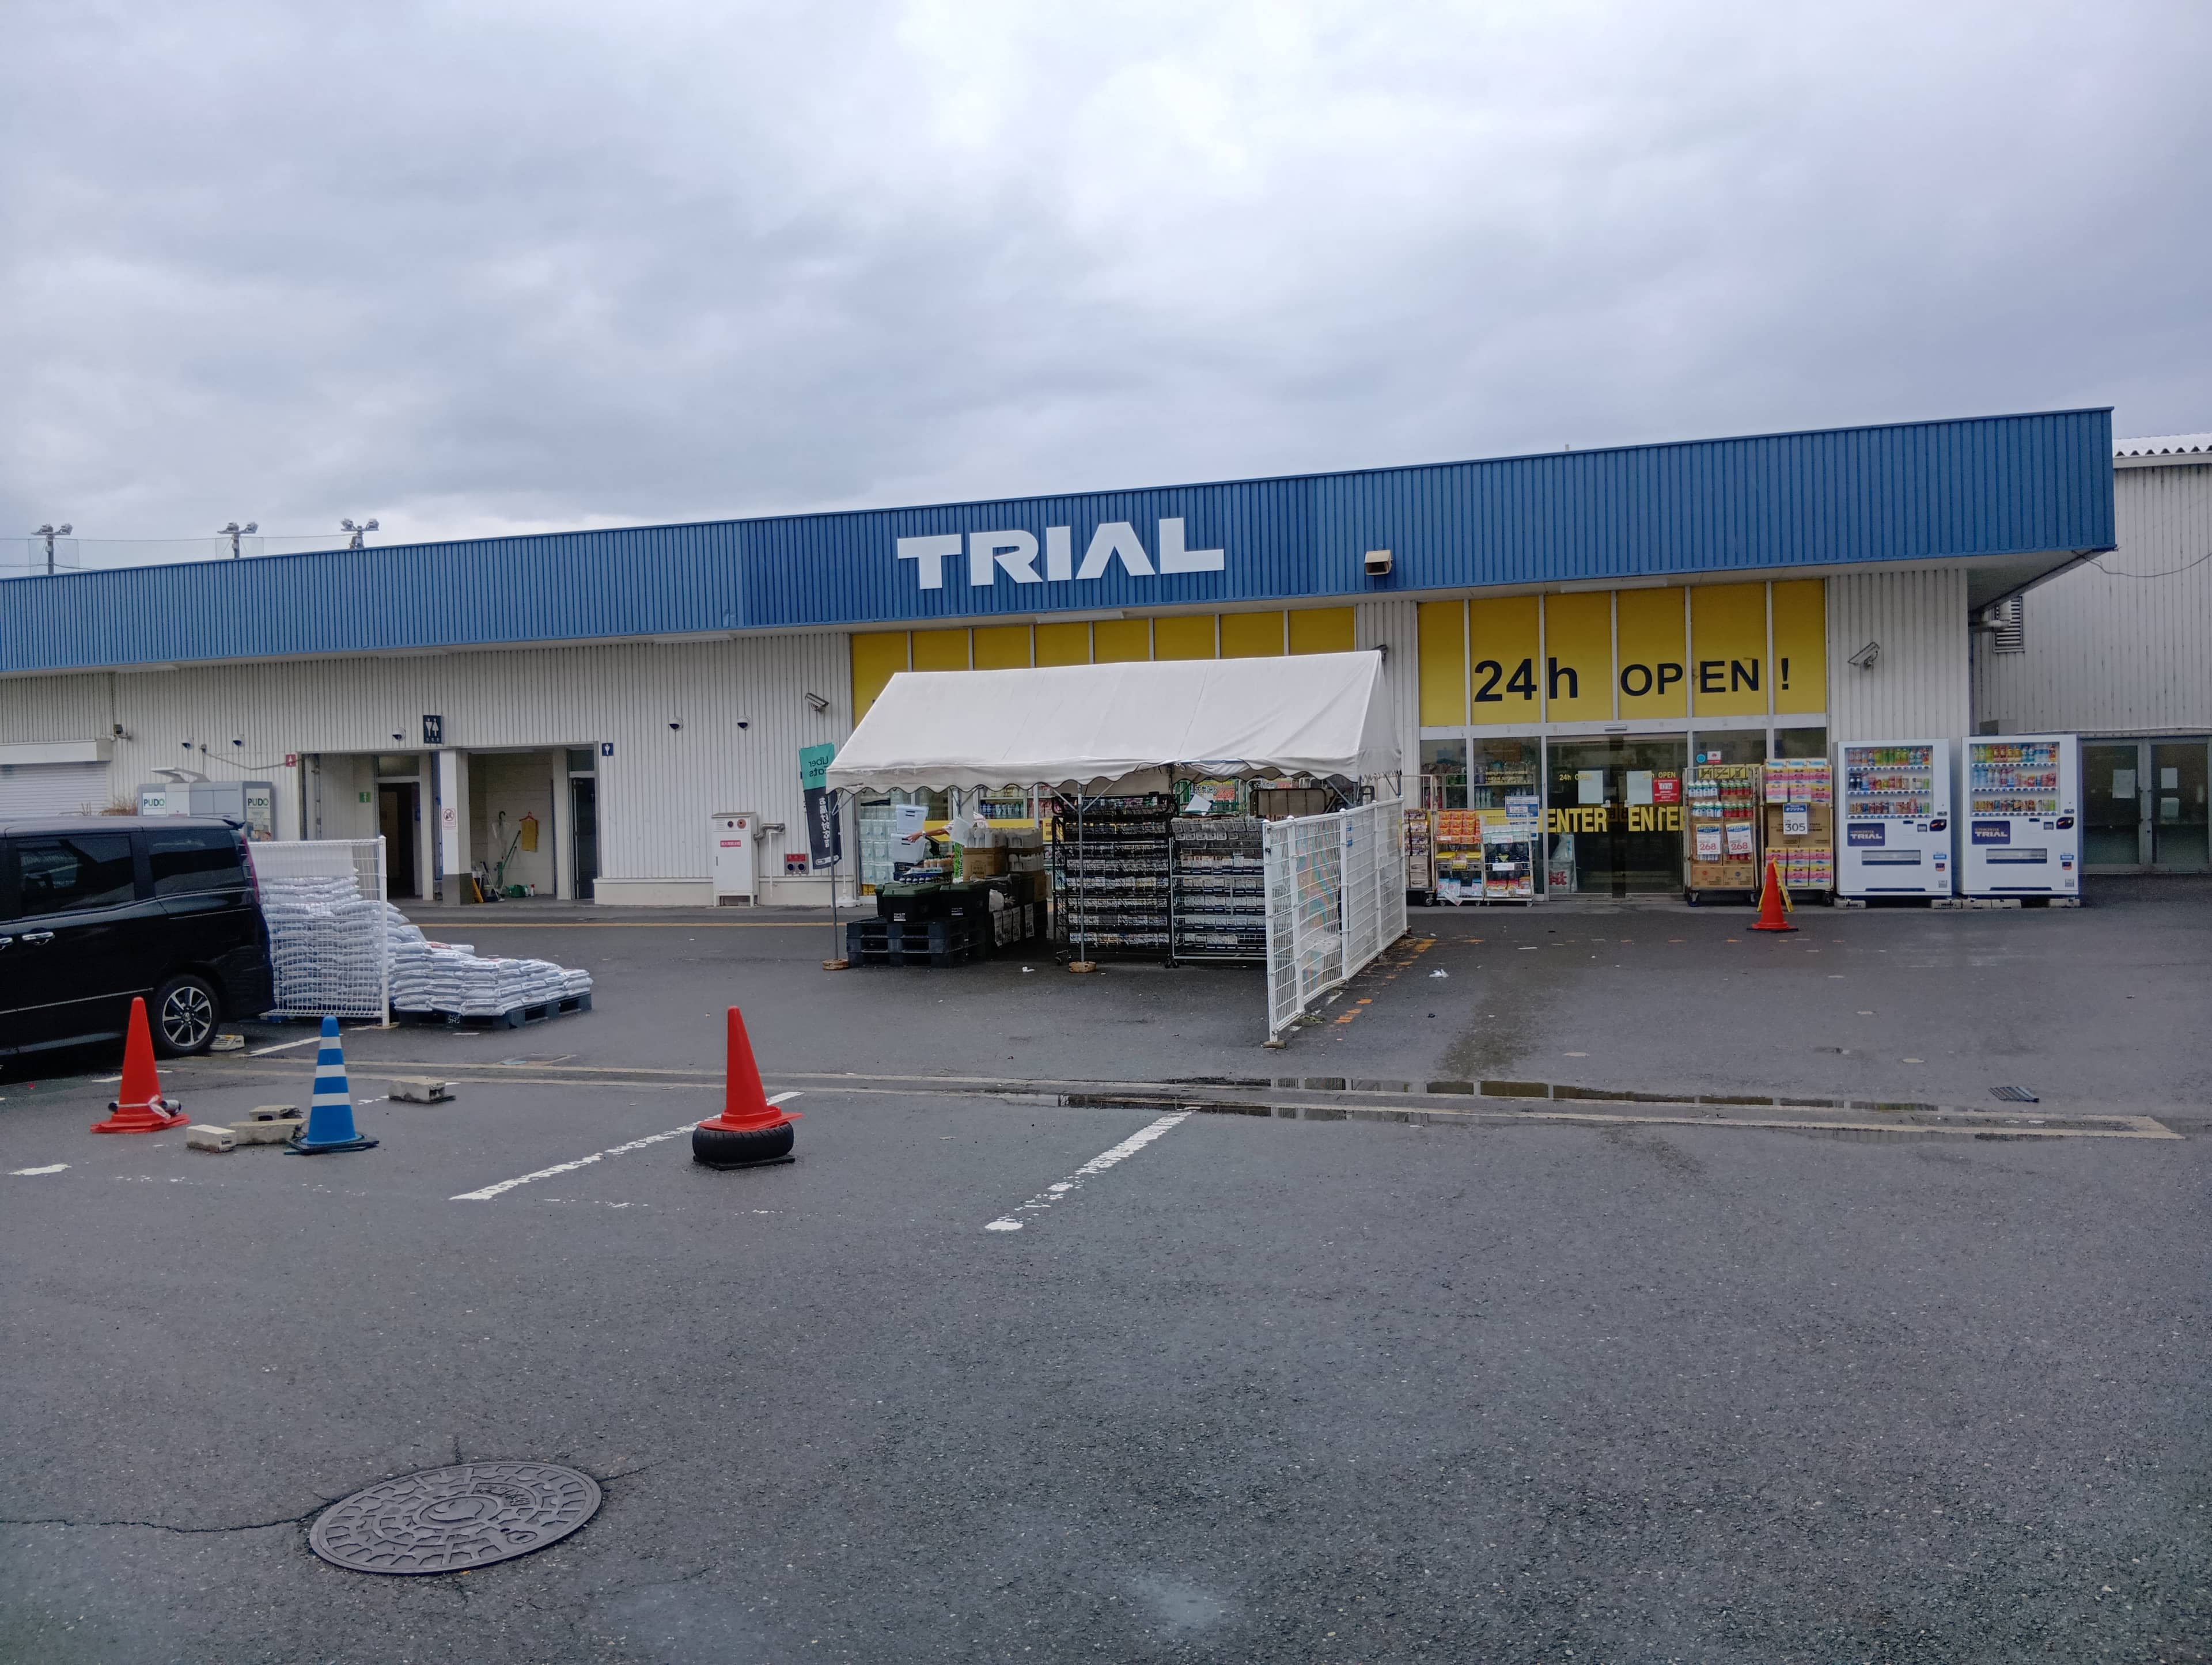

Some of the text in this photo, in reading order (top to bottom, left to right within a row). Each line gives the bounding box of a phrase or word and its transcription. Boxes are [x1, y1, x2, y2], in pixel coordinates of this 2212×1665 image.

[897, 517, 1225, 590] TRIAL
[1474, 657, 1578, 702] 24h
[144, 798, 165, 806] PUDO
[248, 798, 269, 806] PUDO
[1548, 807, 1607, 833] ENTER
[1785, 822, 1806, 832] 305
[1731, 841, 1748, 850] 268
